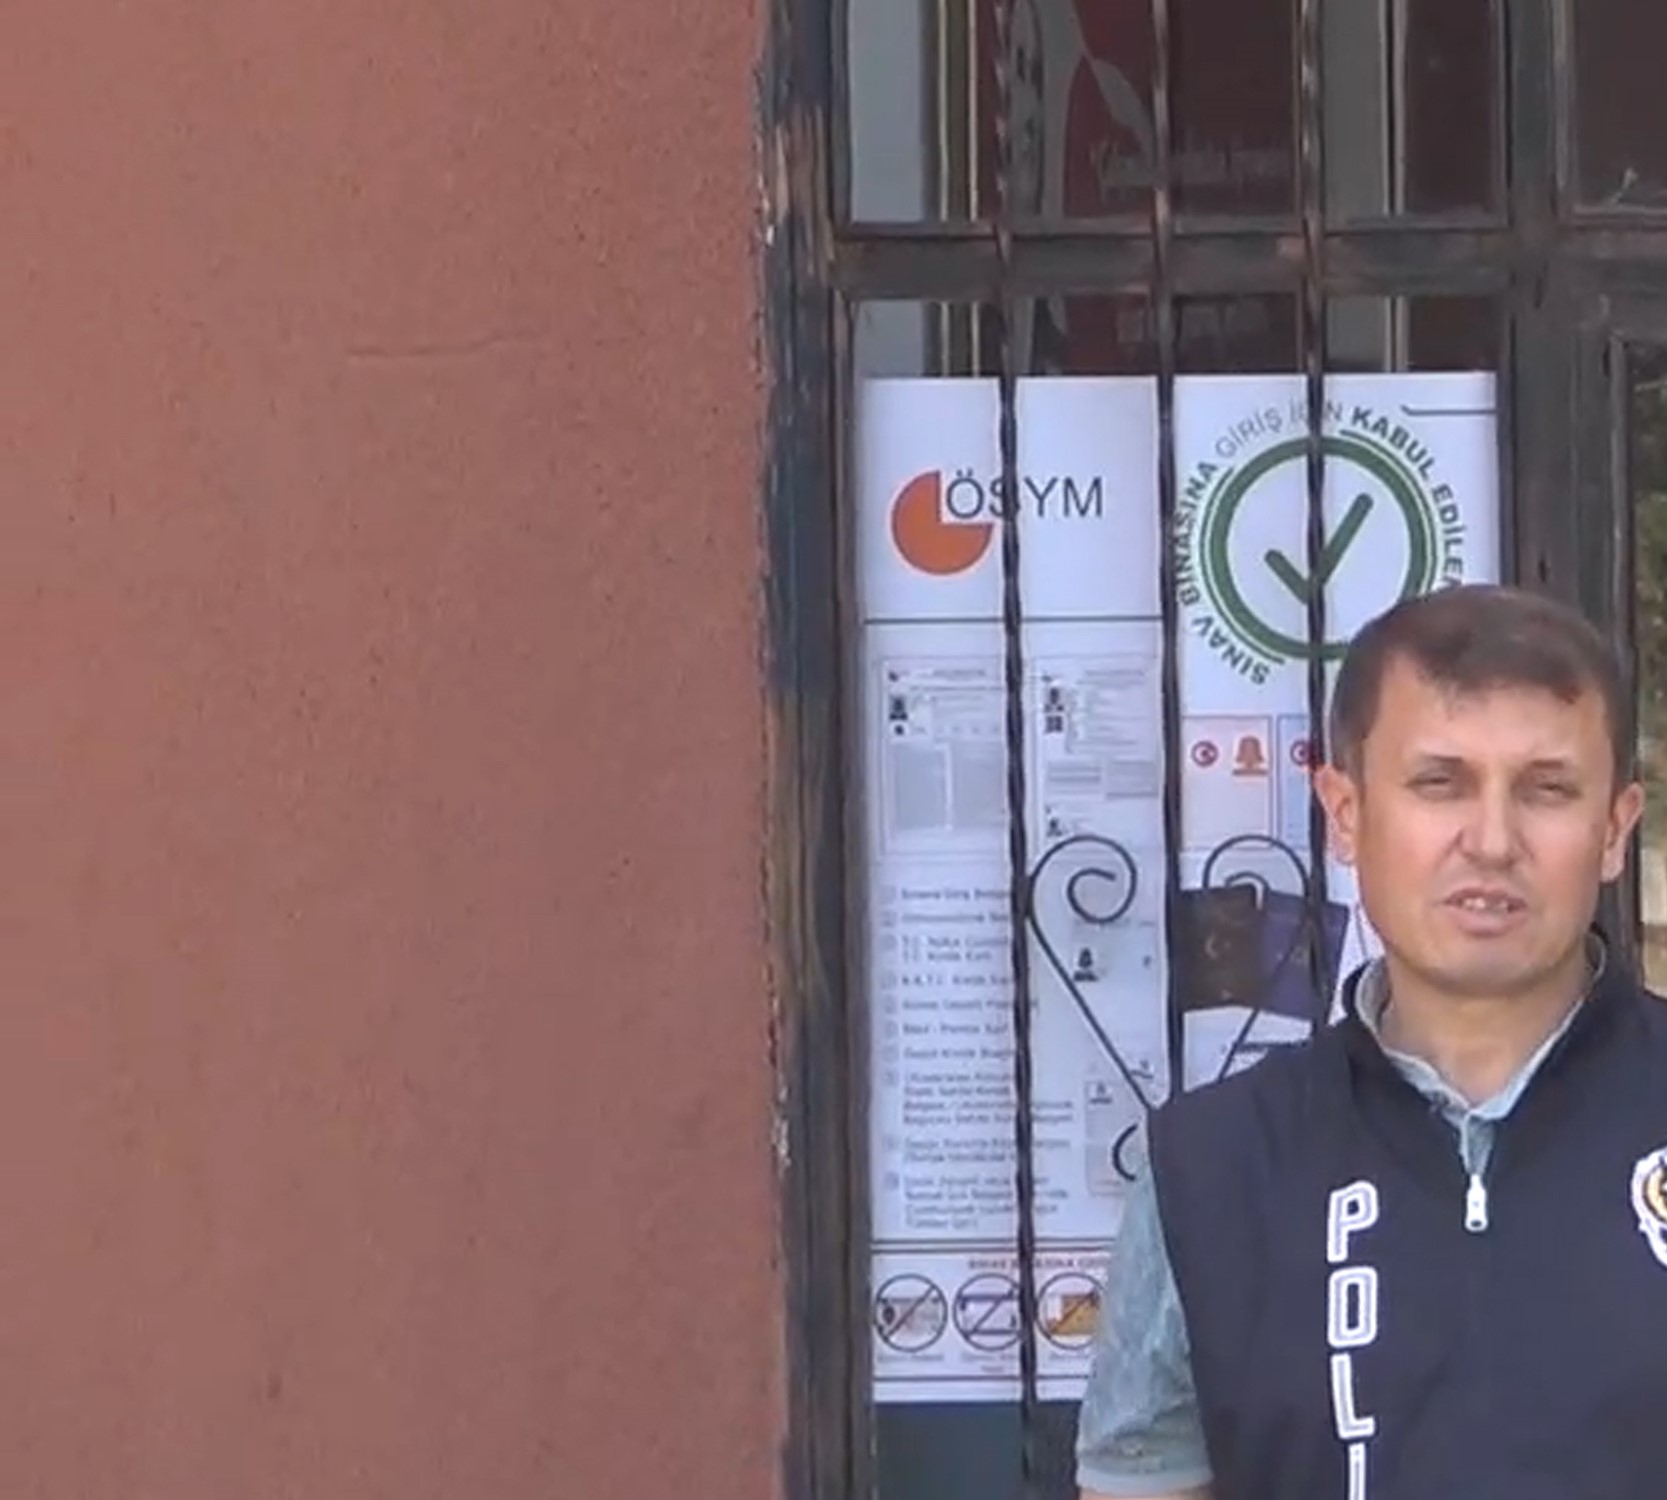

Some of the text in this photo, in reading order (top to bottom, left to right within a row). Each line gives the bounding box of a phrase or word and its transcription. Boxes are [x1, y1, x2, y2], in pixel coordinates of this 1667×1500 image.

[1215, 405, 1283, 459] GİRİŞ
[1352, 405, 1435, 481] KABUL
[1192, 615, 1270, 685] SINAV
